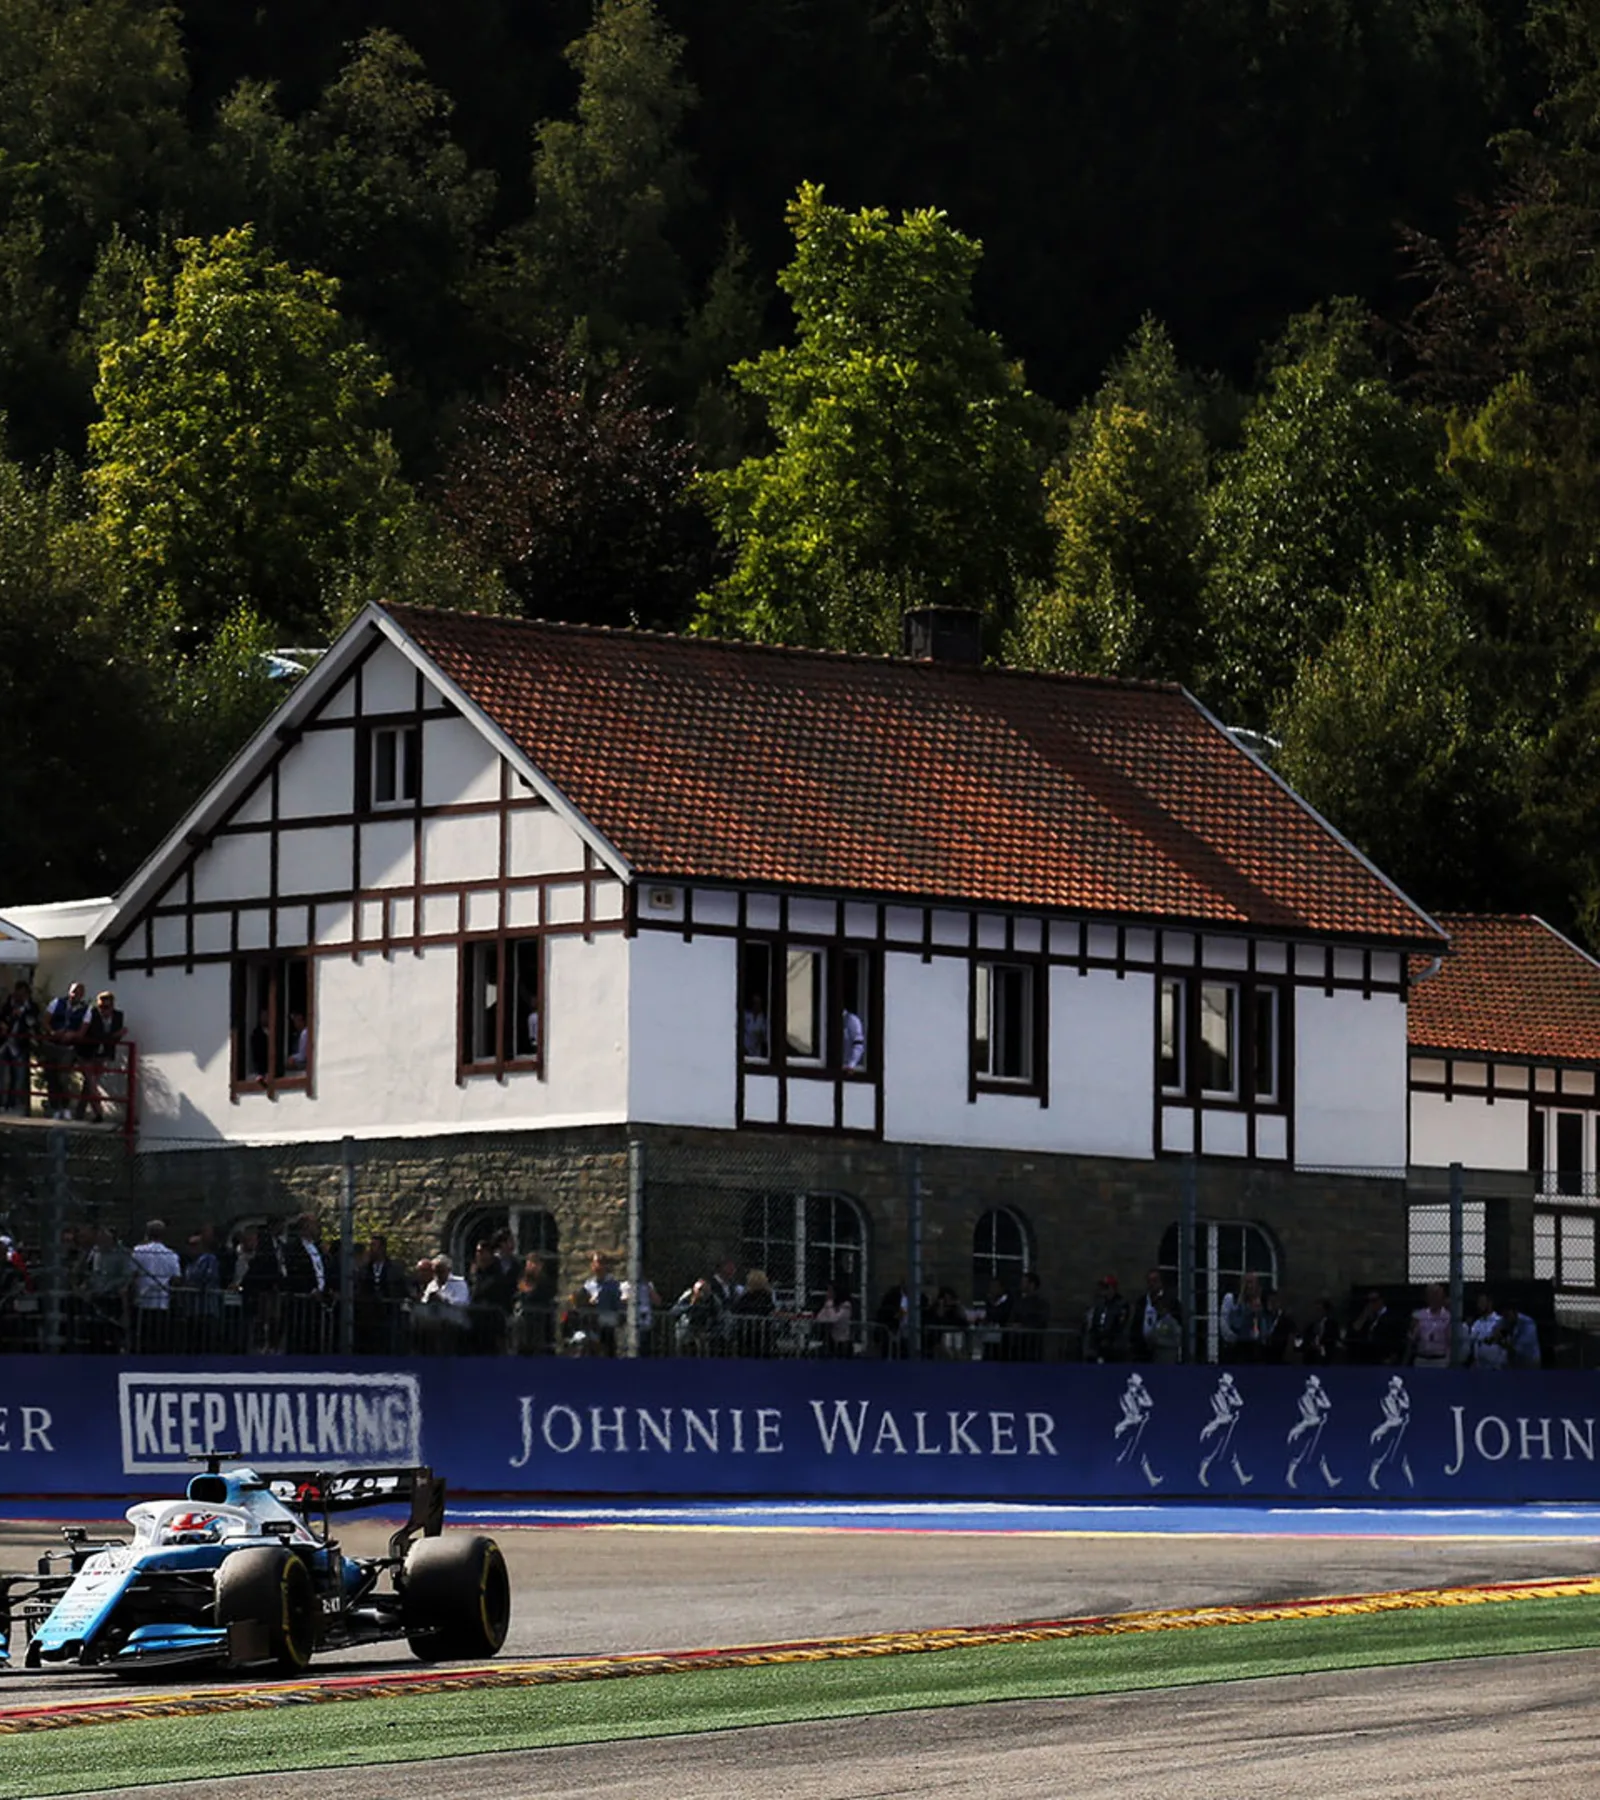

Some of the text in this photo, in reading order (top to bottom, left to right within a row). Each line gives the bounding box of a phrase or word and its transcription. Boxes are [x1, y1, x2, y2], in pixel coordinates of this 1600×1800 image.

[134, 1391, 407, 1455] KEEP WALKING
[508, 1395, 1059, 1468] JOHNNIE WALKER
[1443, 1405, 1597, 1476] JOHN
